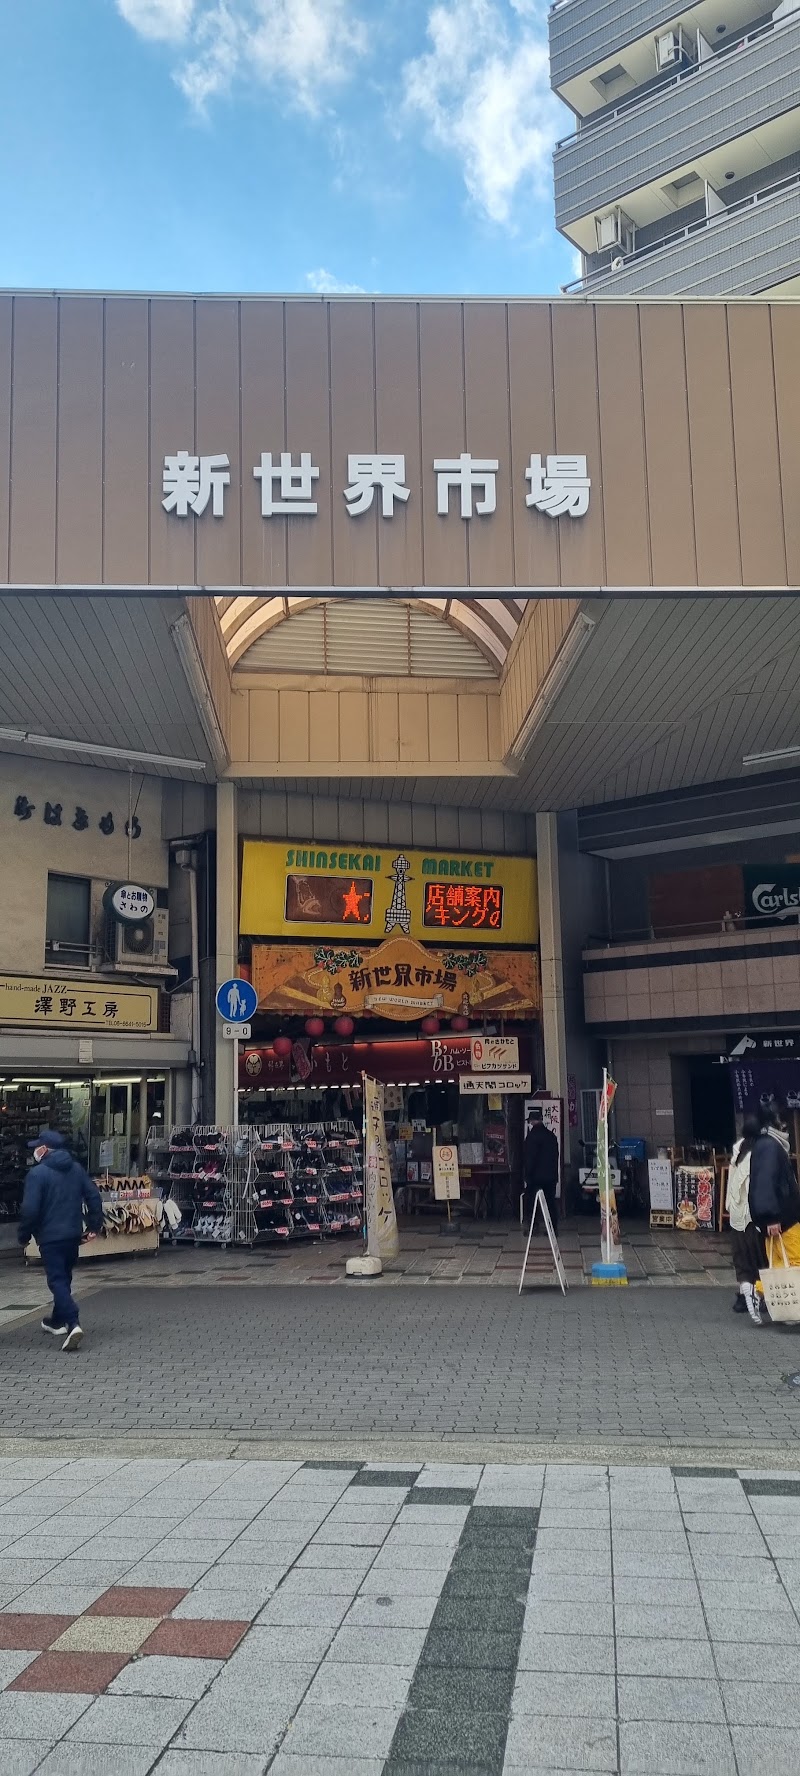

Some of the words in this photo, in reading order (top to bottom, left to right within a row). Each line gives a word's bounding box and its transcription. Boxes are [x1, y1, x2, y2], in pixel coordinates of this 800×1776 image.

[161, 450, 592, 519] 新世界市場
[286, 850, 381, 872] SHINSEKAI
[422, 858, 494, 878] MARKET
[119, 901, 149, 914] さわの
[428, 884, 500, 908] 店舗案内
[752, 884, 800, 914] Carls
[5, 982, 41, 993] hand-made
[42, 984, 67, 995] JAZZ
[348, 963, 458, 992] 新世界市場
[34, 996, 119, 1018] 澤野工房
[763, 1038, 795, 1048] 新世界
[652, 1215, 673, 1223] 営業中
